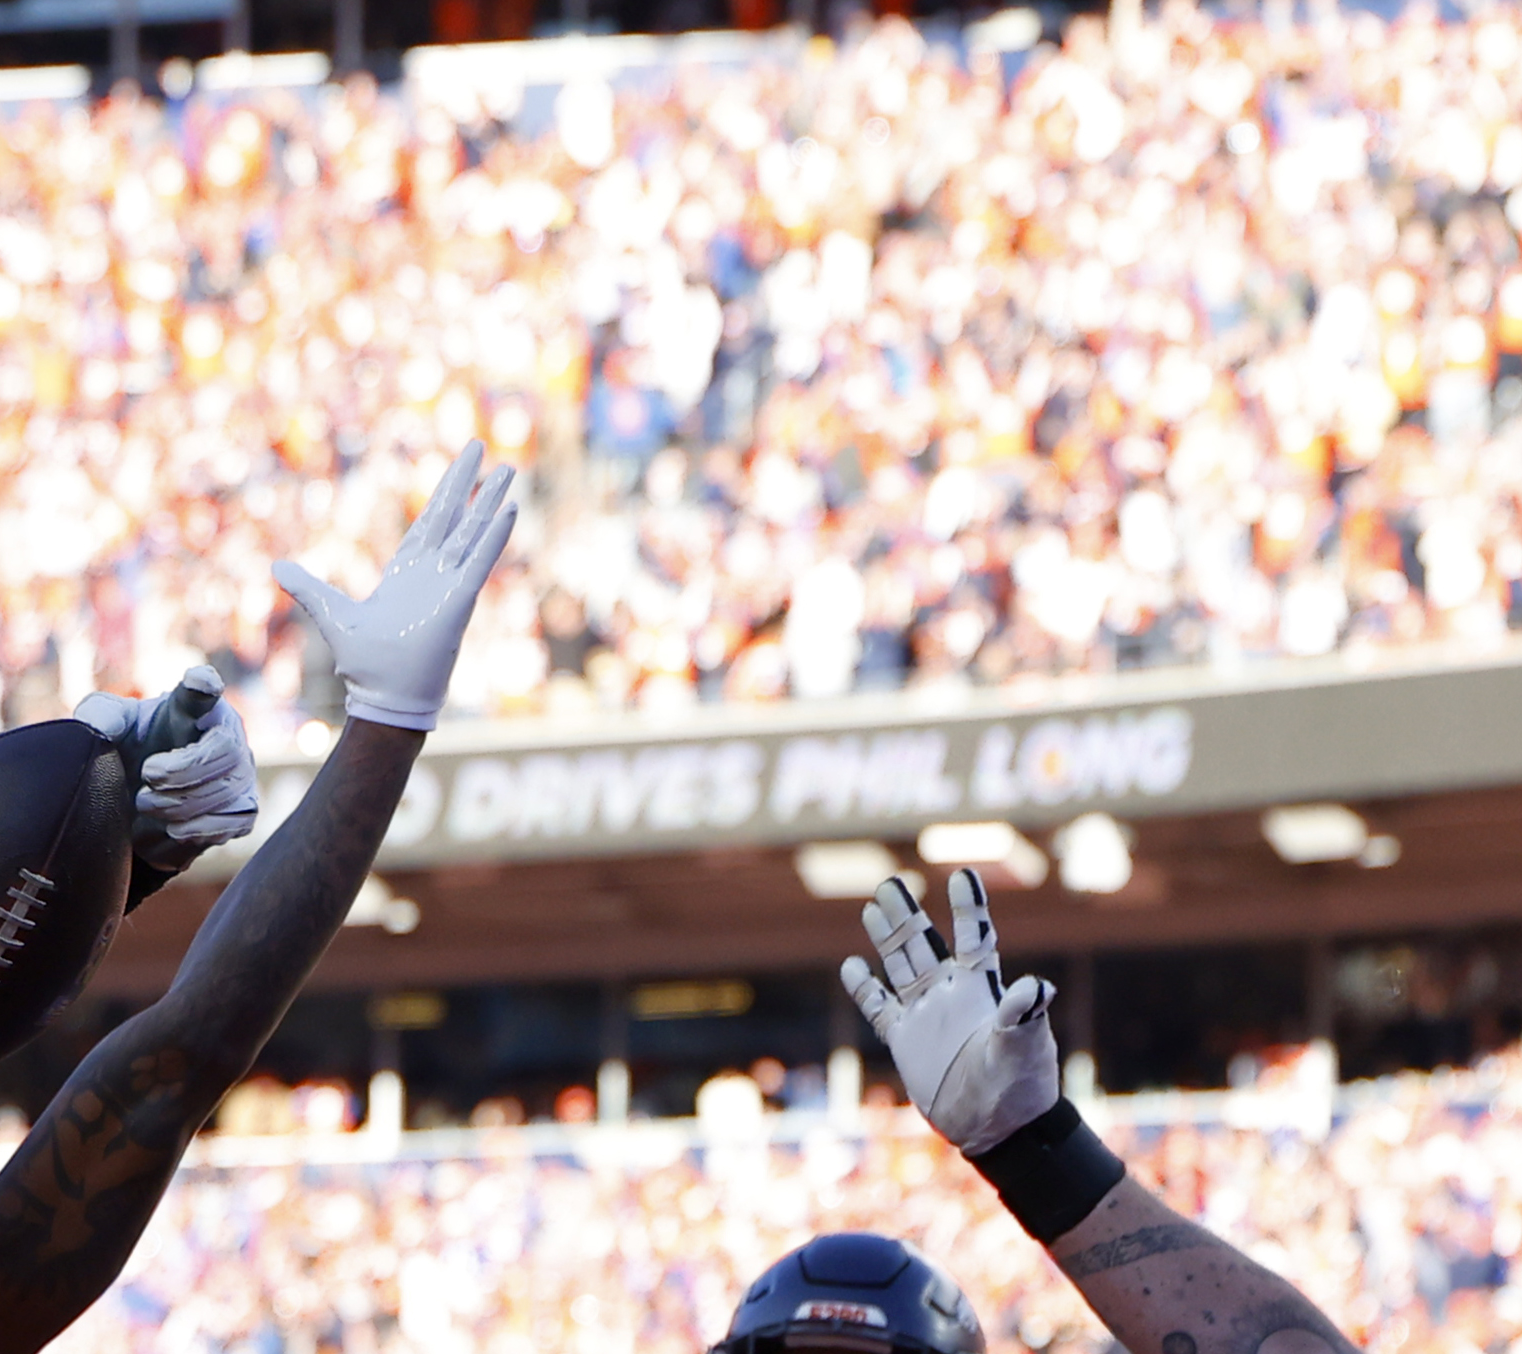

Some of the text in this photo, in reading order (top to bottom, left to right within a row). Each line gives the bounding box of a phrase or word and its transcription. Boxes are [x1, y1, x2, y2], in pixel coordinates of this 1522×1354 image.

[449, 738, 762, 842] DRIVES
[768, 727, 956, 823] PHIL
[969, 704, 1195, 811] LONG
